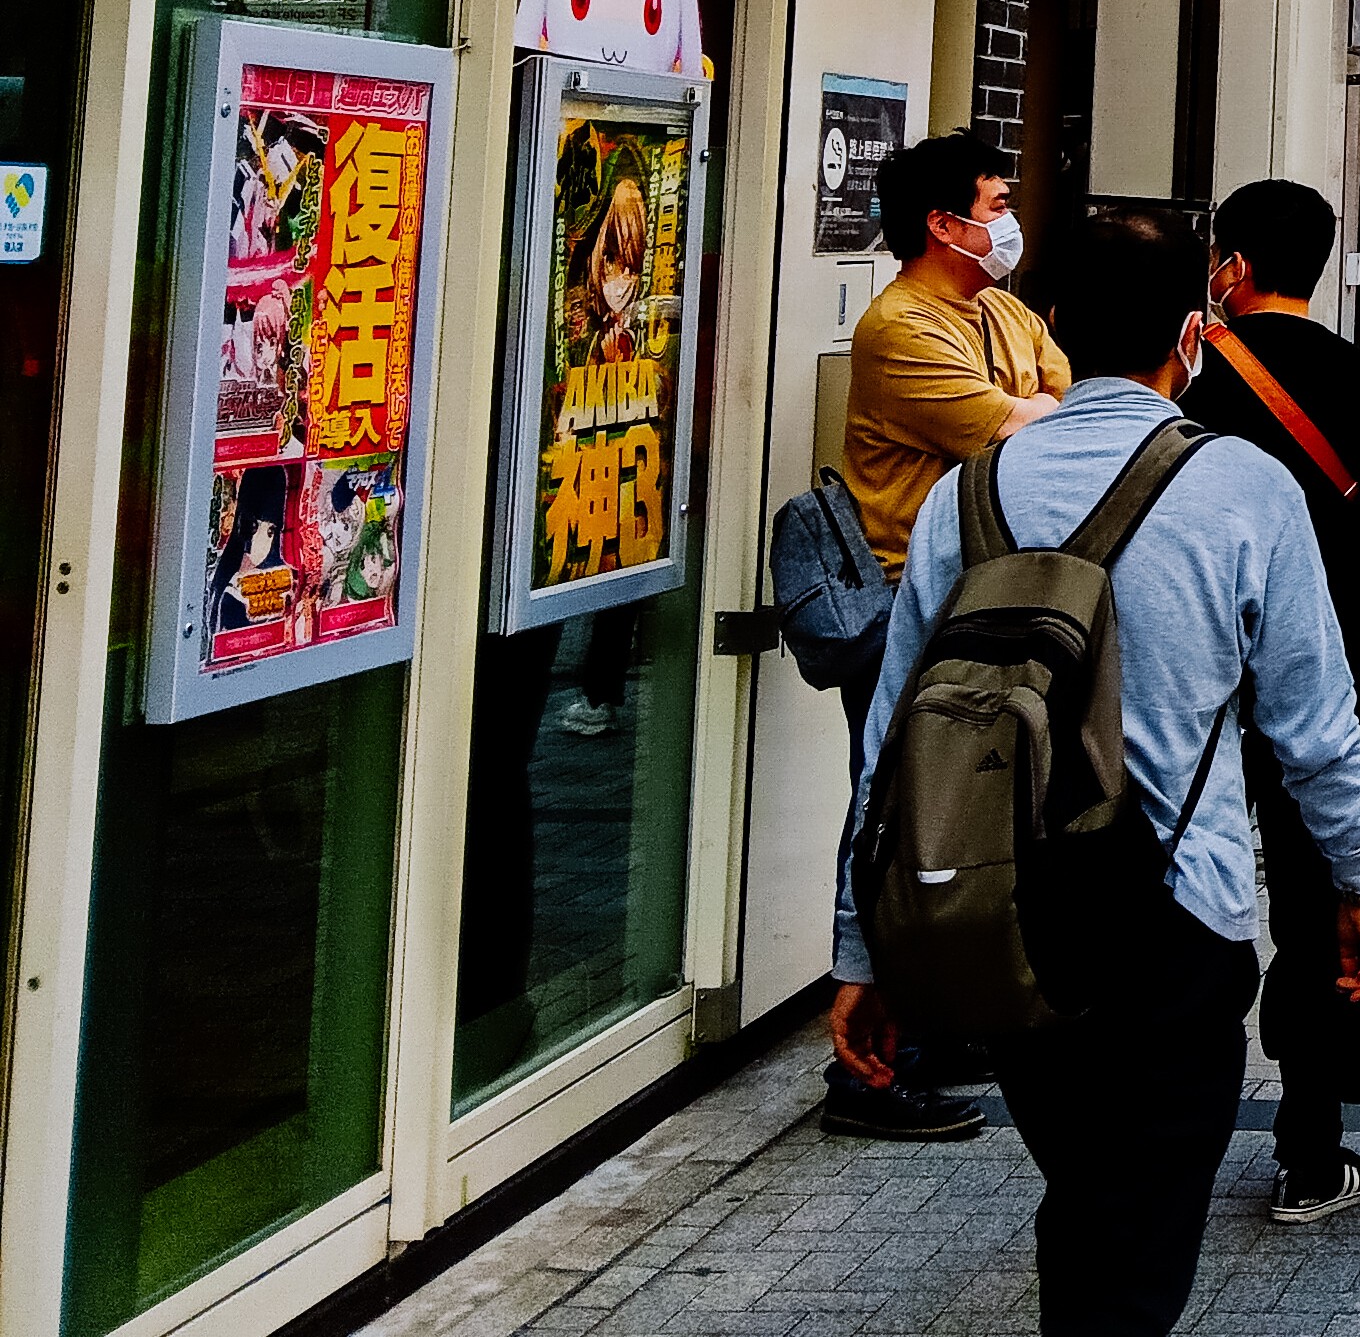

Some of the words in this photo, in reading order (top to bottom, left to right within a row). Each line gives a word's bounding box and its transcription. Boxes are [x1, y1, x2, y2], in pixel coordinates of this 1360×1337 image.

[322, 122, 408, 410] 復活
[319, 406, 382, 451] 導入
[562, 358, 660, 431] AKIBA
